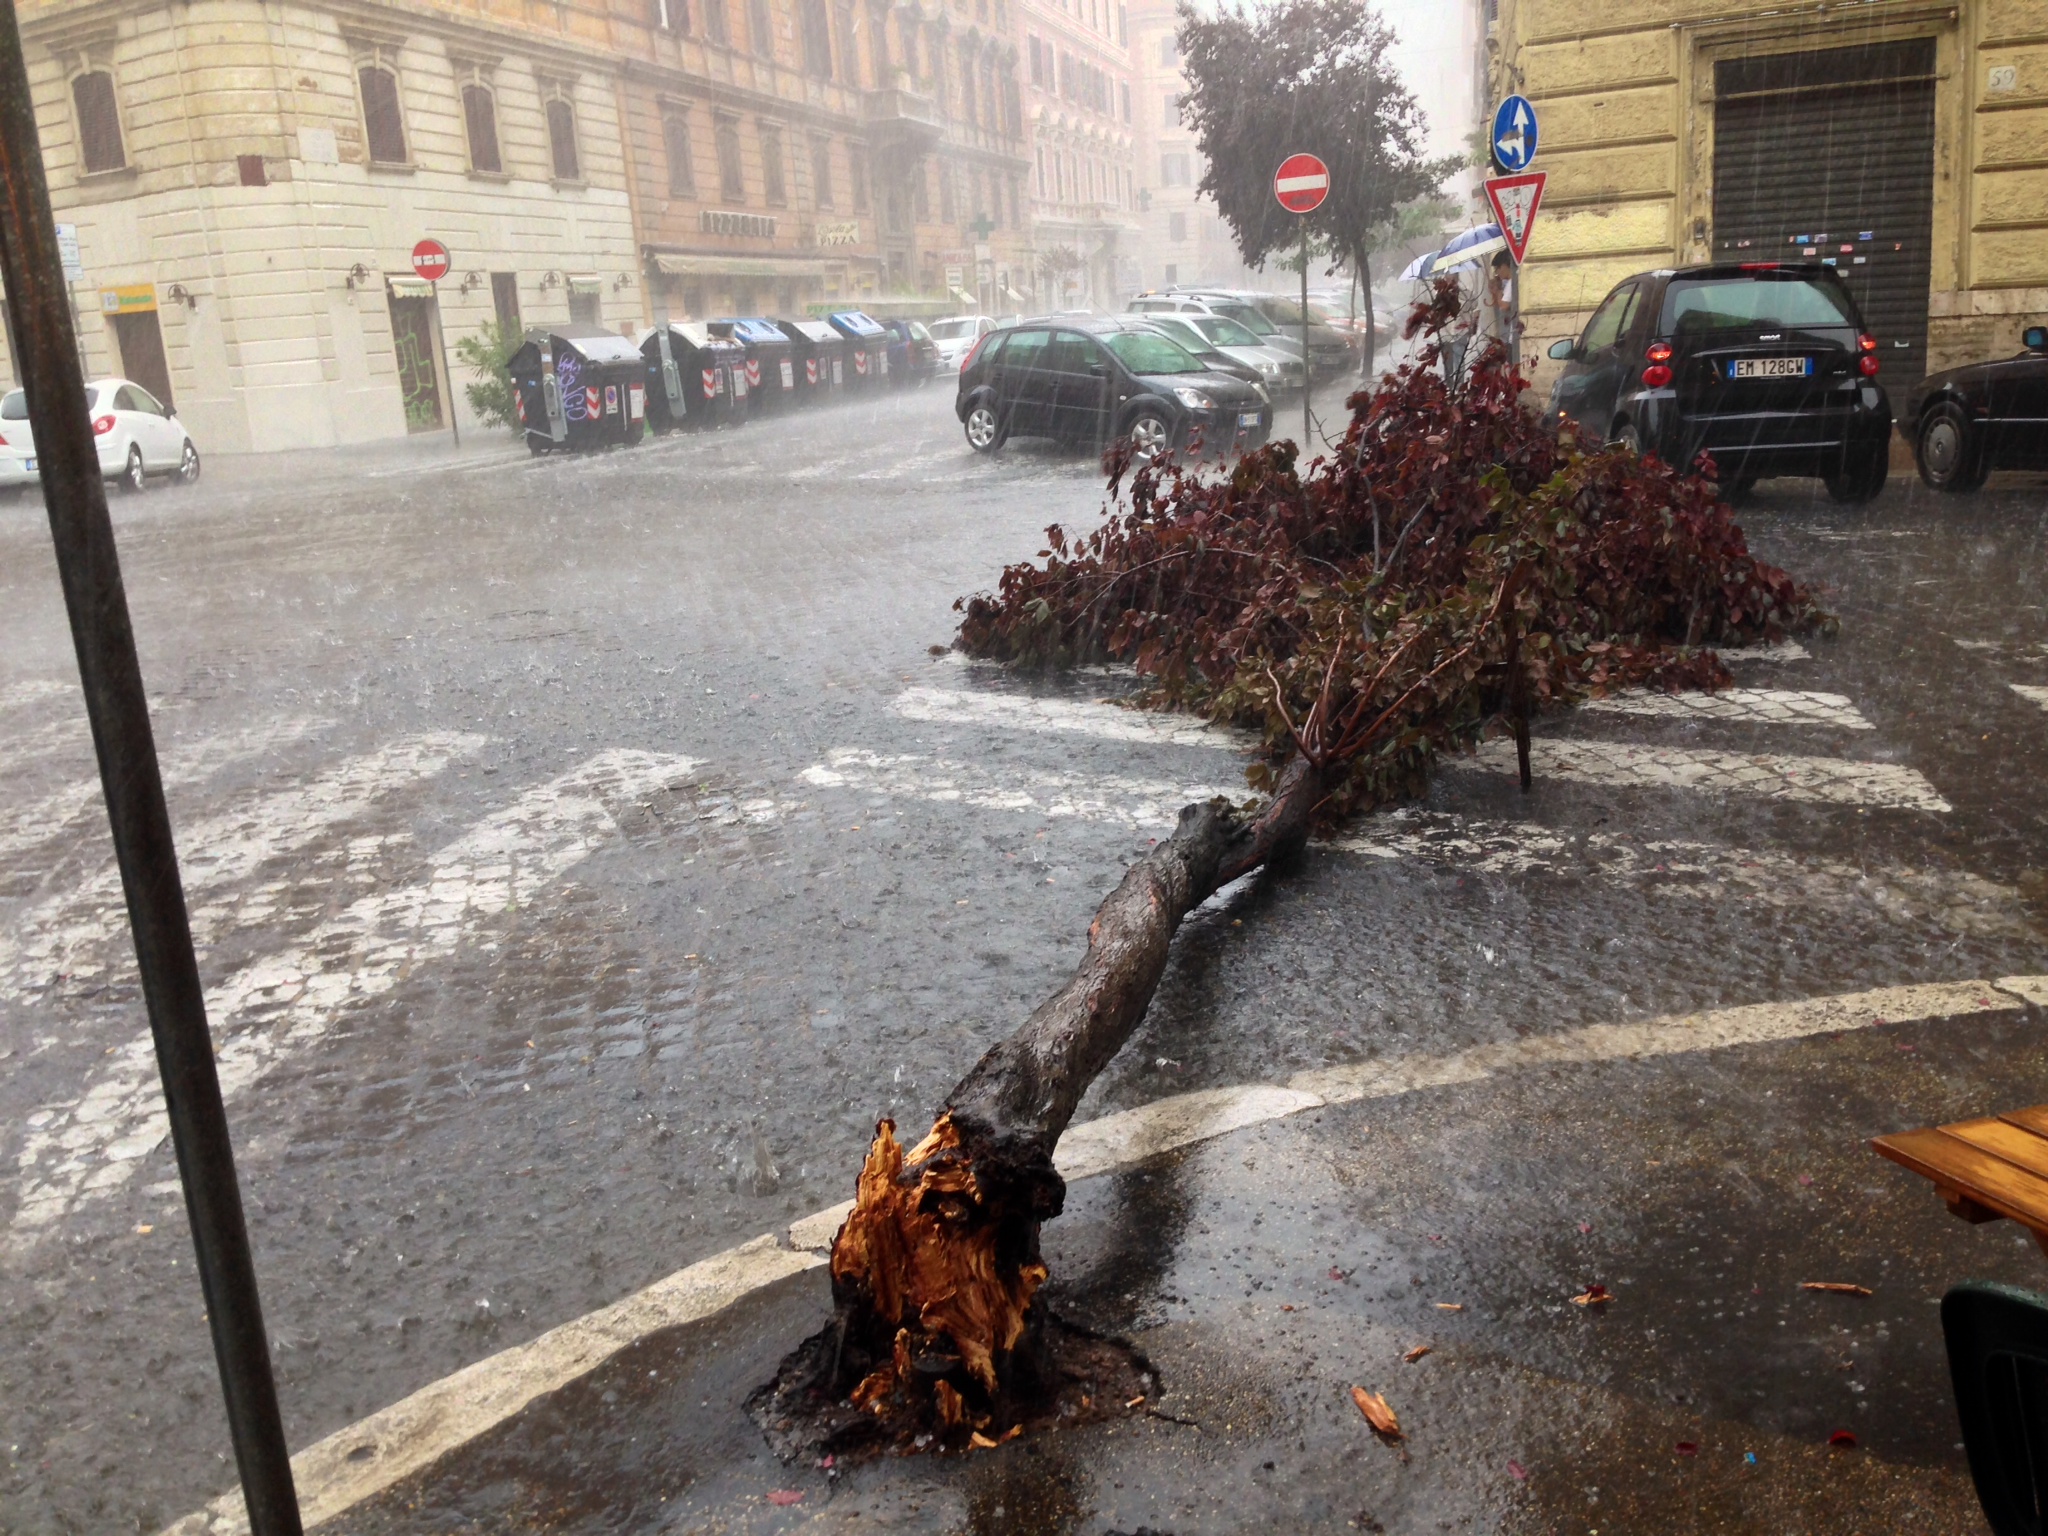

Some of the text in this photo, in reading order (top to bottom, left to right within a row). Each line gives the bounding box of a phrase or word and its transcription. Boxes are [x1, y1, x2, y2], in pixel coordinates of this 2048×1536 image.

[1991, 69, 2015, 87] 59
[820, 235, 856, 246] PIZZA
[1736, 359, 1804, 376] EM 128GW
